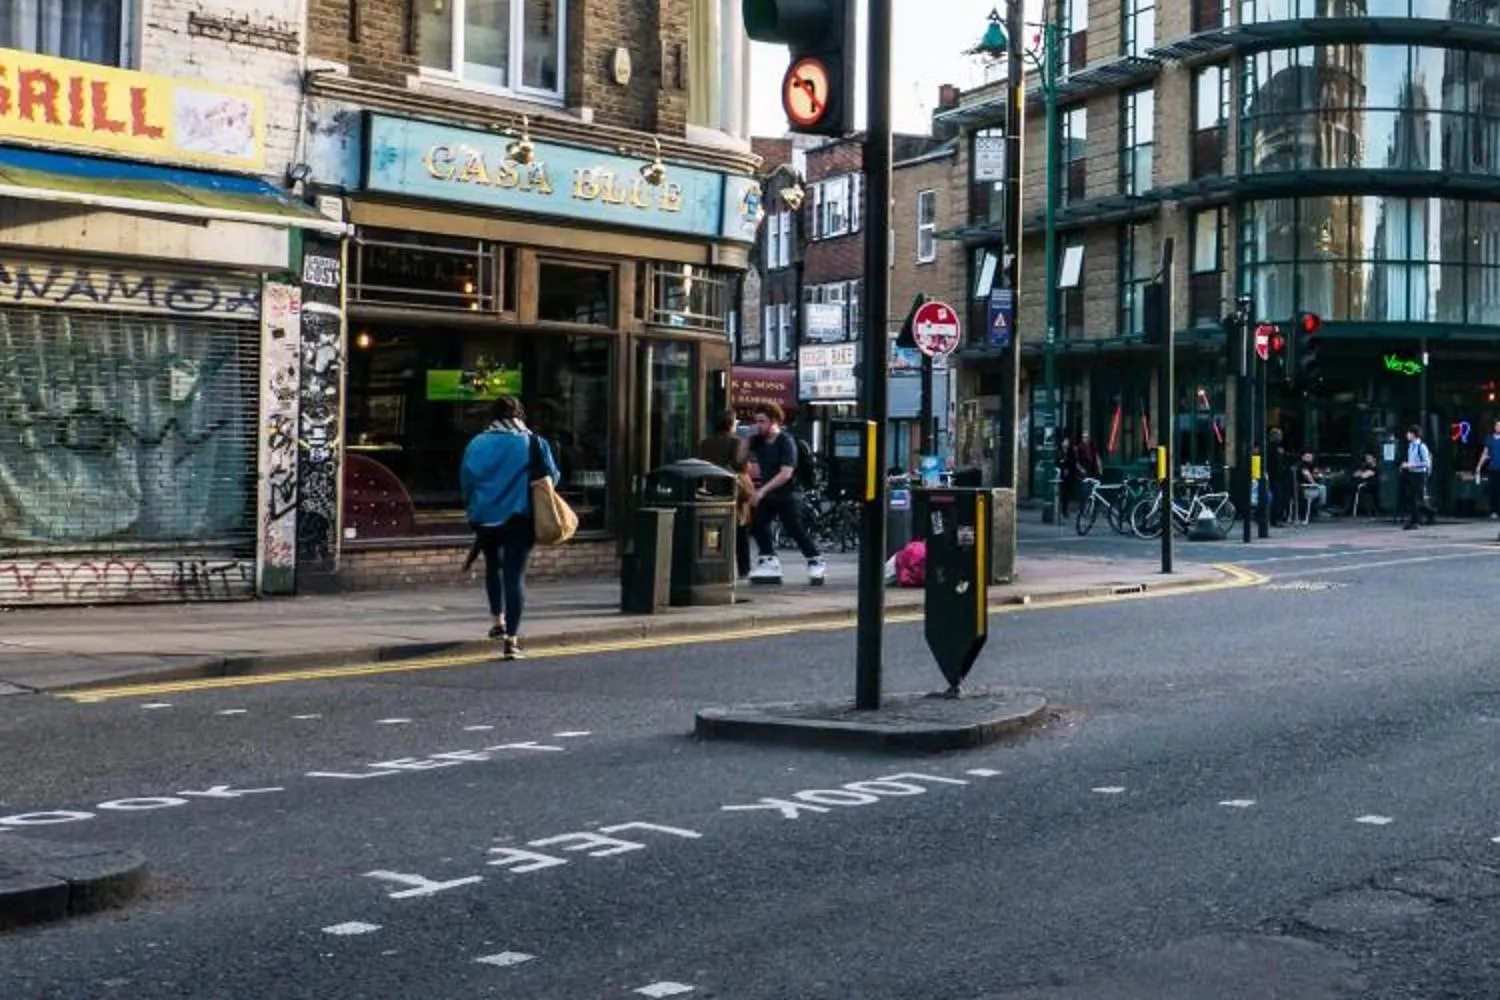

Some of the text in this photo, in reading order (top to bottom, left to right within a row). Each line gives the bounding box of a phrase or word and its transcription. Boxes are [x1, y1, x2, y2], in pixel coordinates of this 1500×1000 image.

[0, 64, 164, 139] RILL
[422, 143, 553, 195] CASA
[304, 741, 564, 778] LEFT
[364, 772, 968, 898] LOOK LEFT
